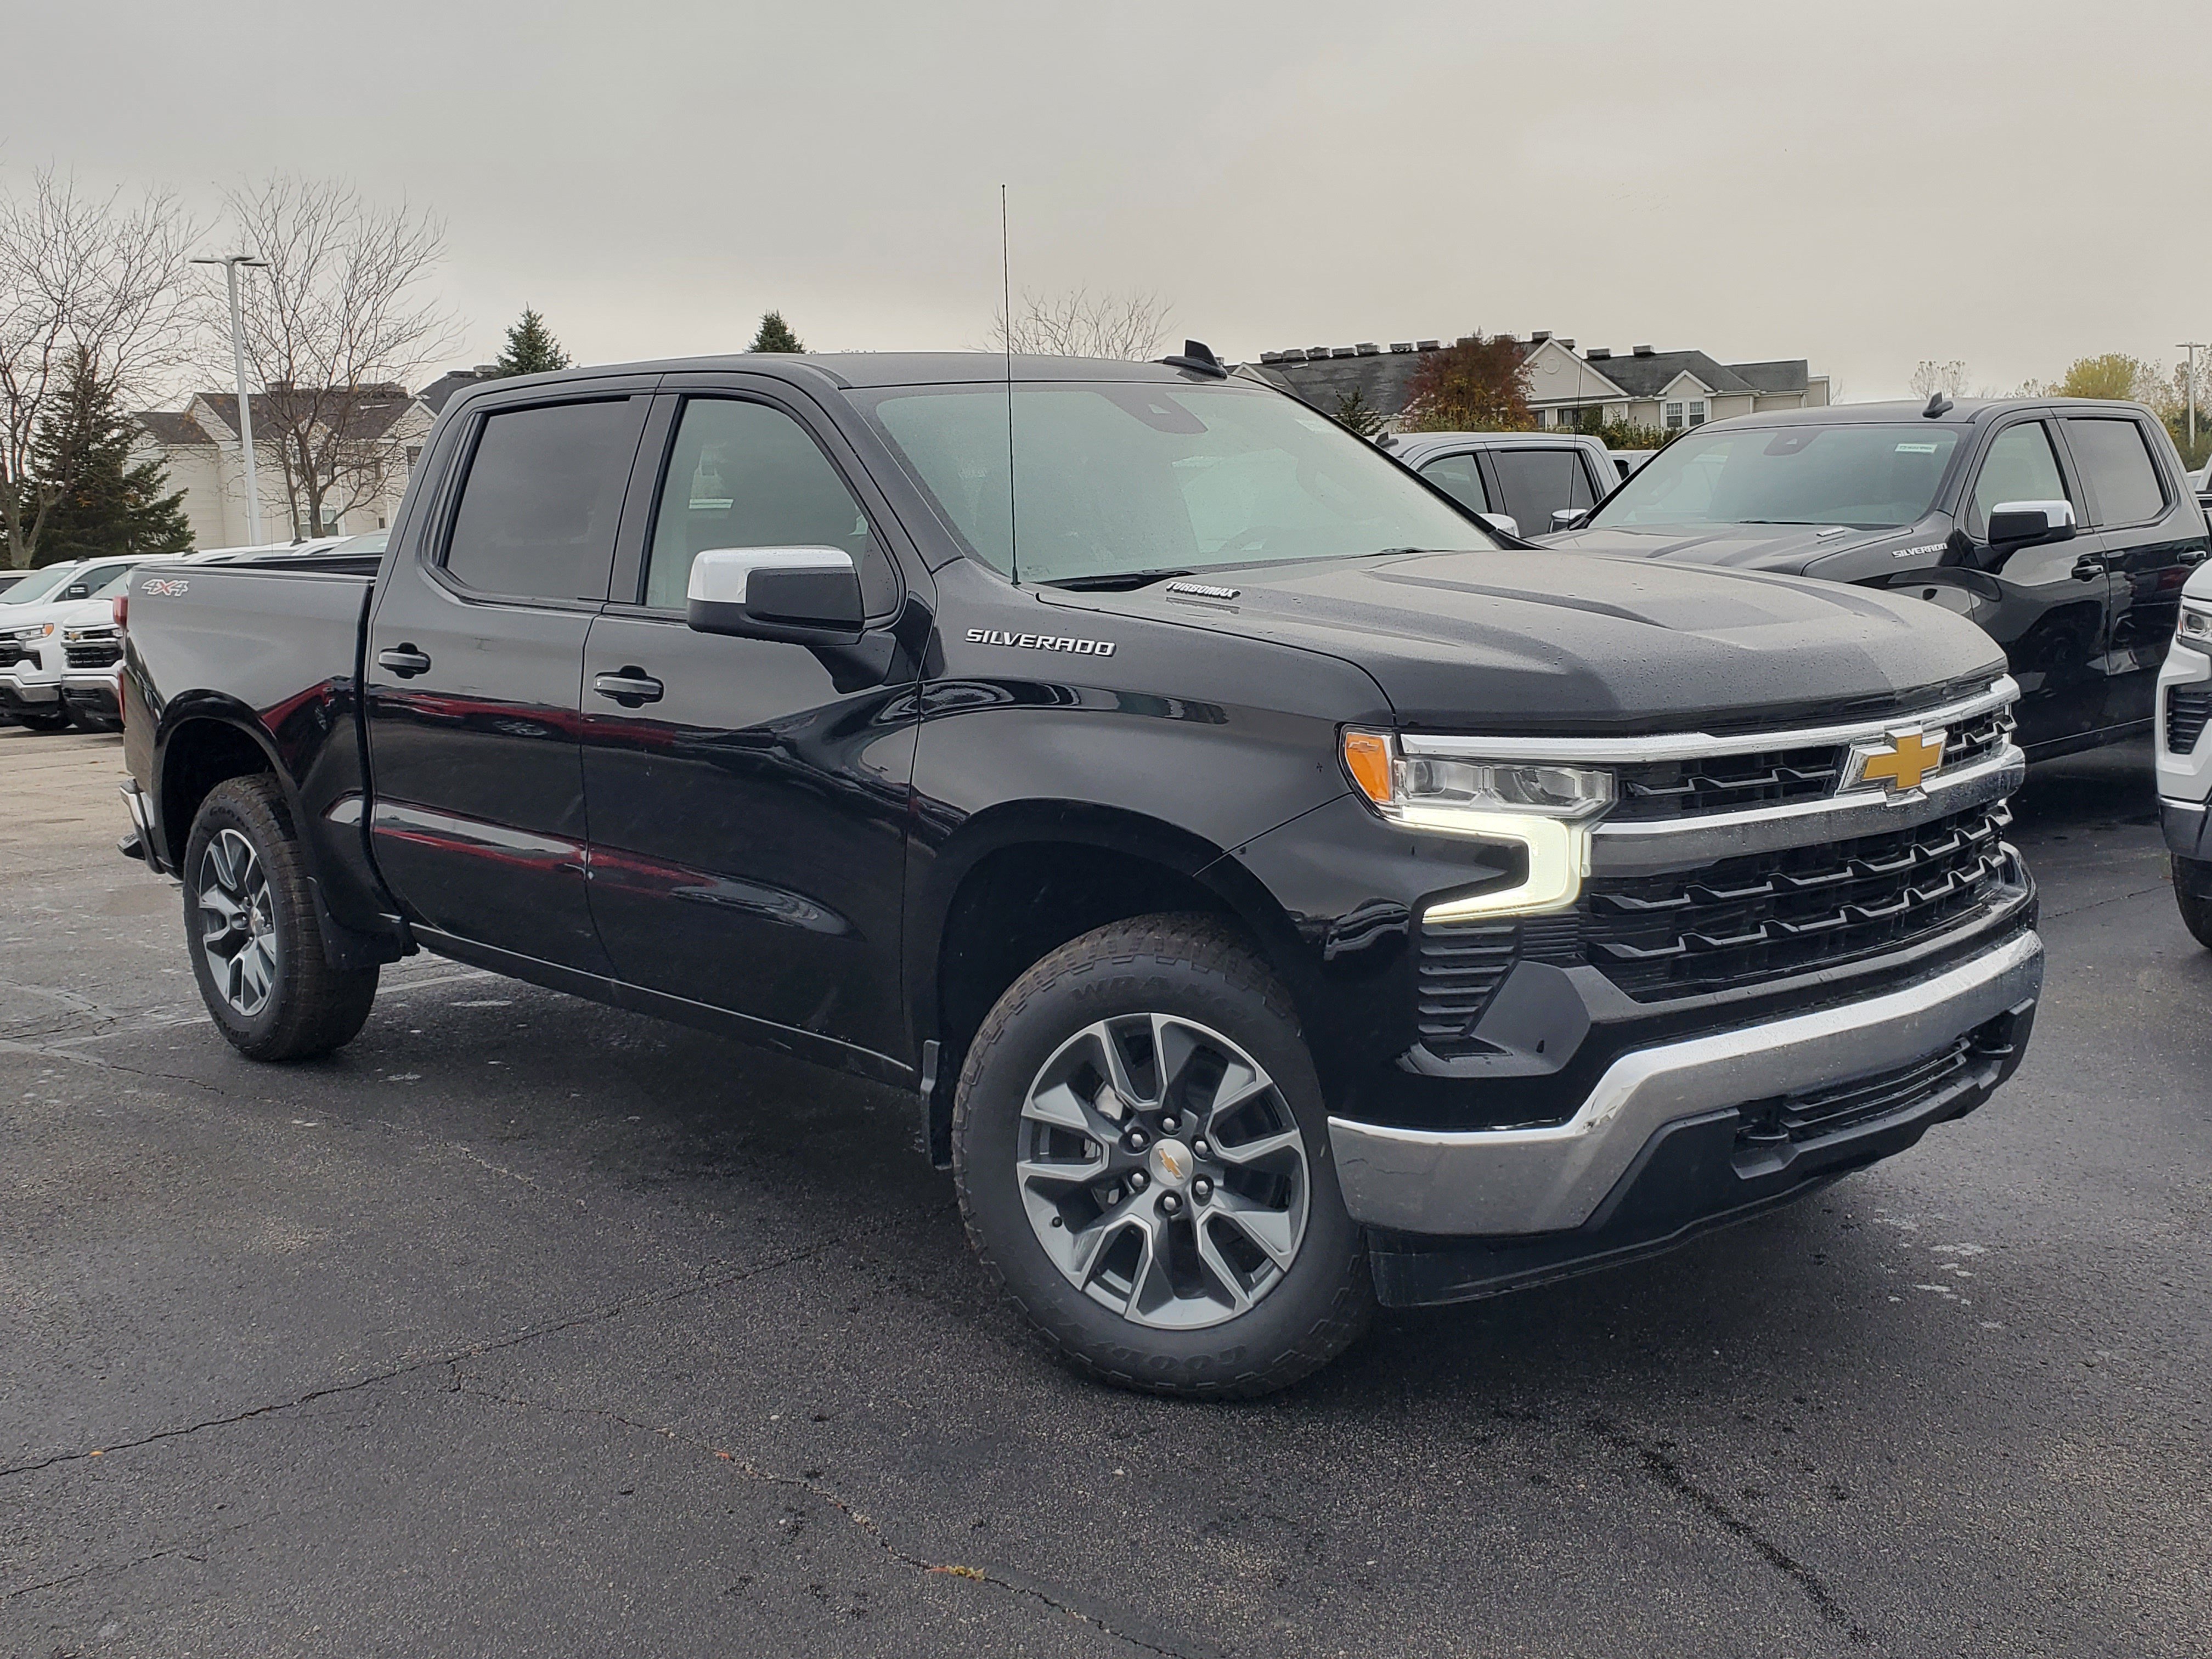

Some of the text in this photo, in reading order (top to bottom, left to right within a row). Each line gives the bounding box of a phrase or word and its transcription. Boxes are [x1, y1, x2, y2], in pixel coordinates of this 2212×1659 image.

[1892, 543, 1948, 558] SILVERADO
[1166, 581, 1240, 600] TURBOMAX
[965, 628, 1117, 657] SILVERADO
